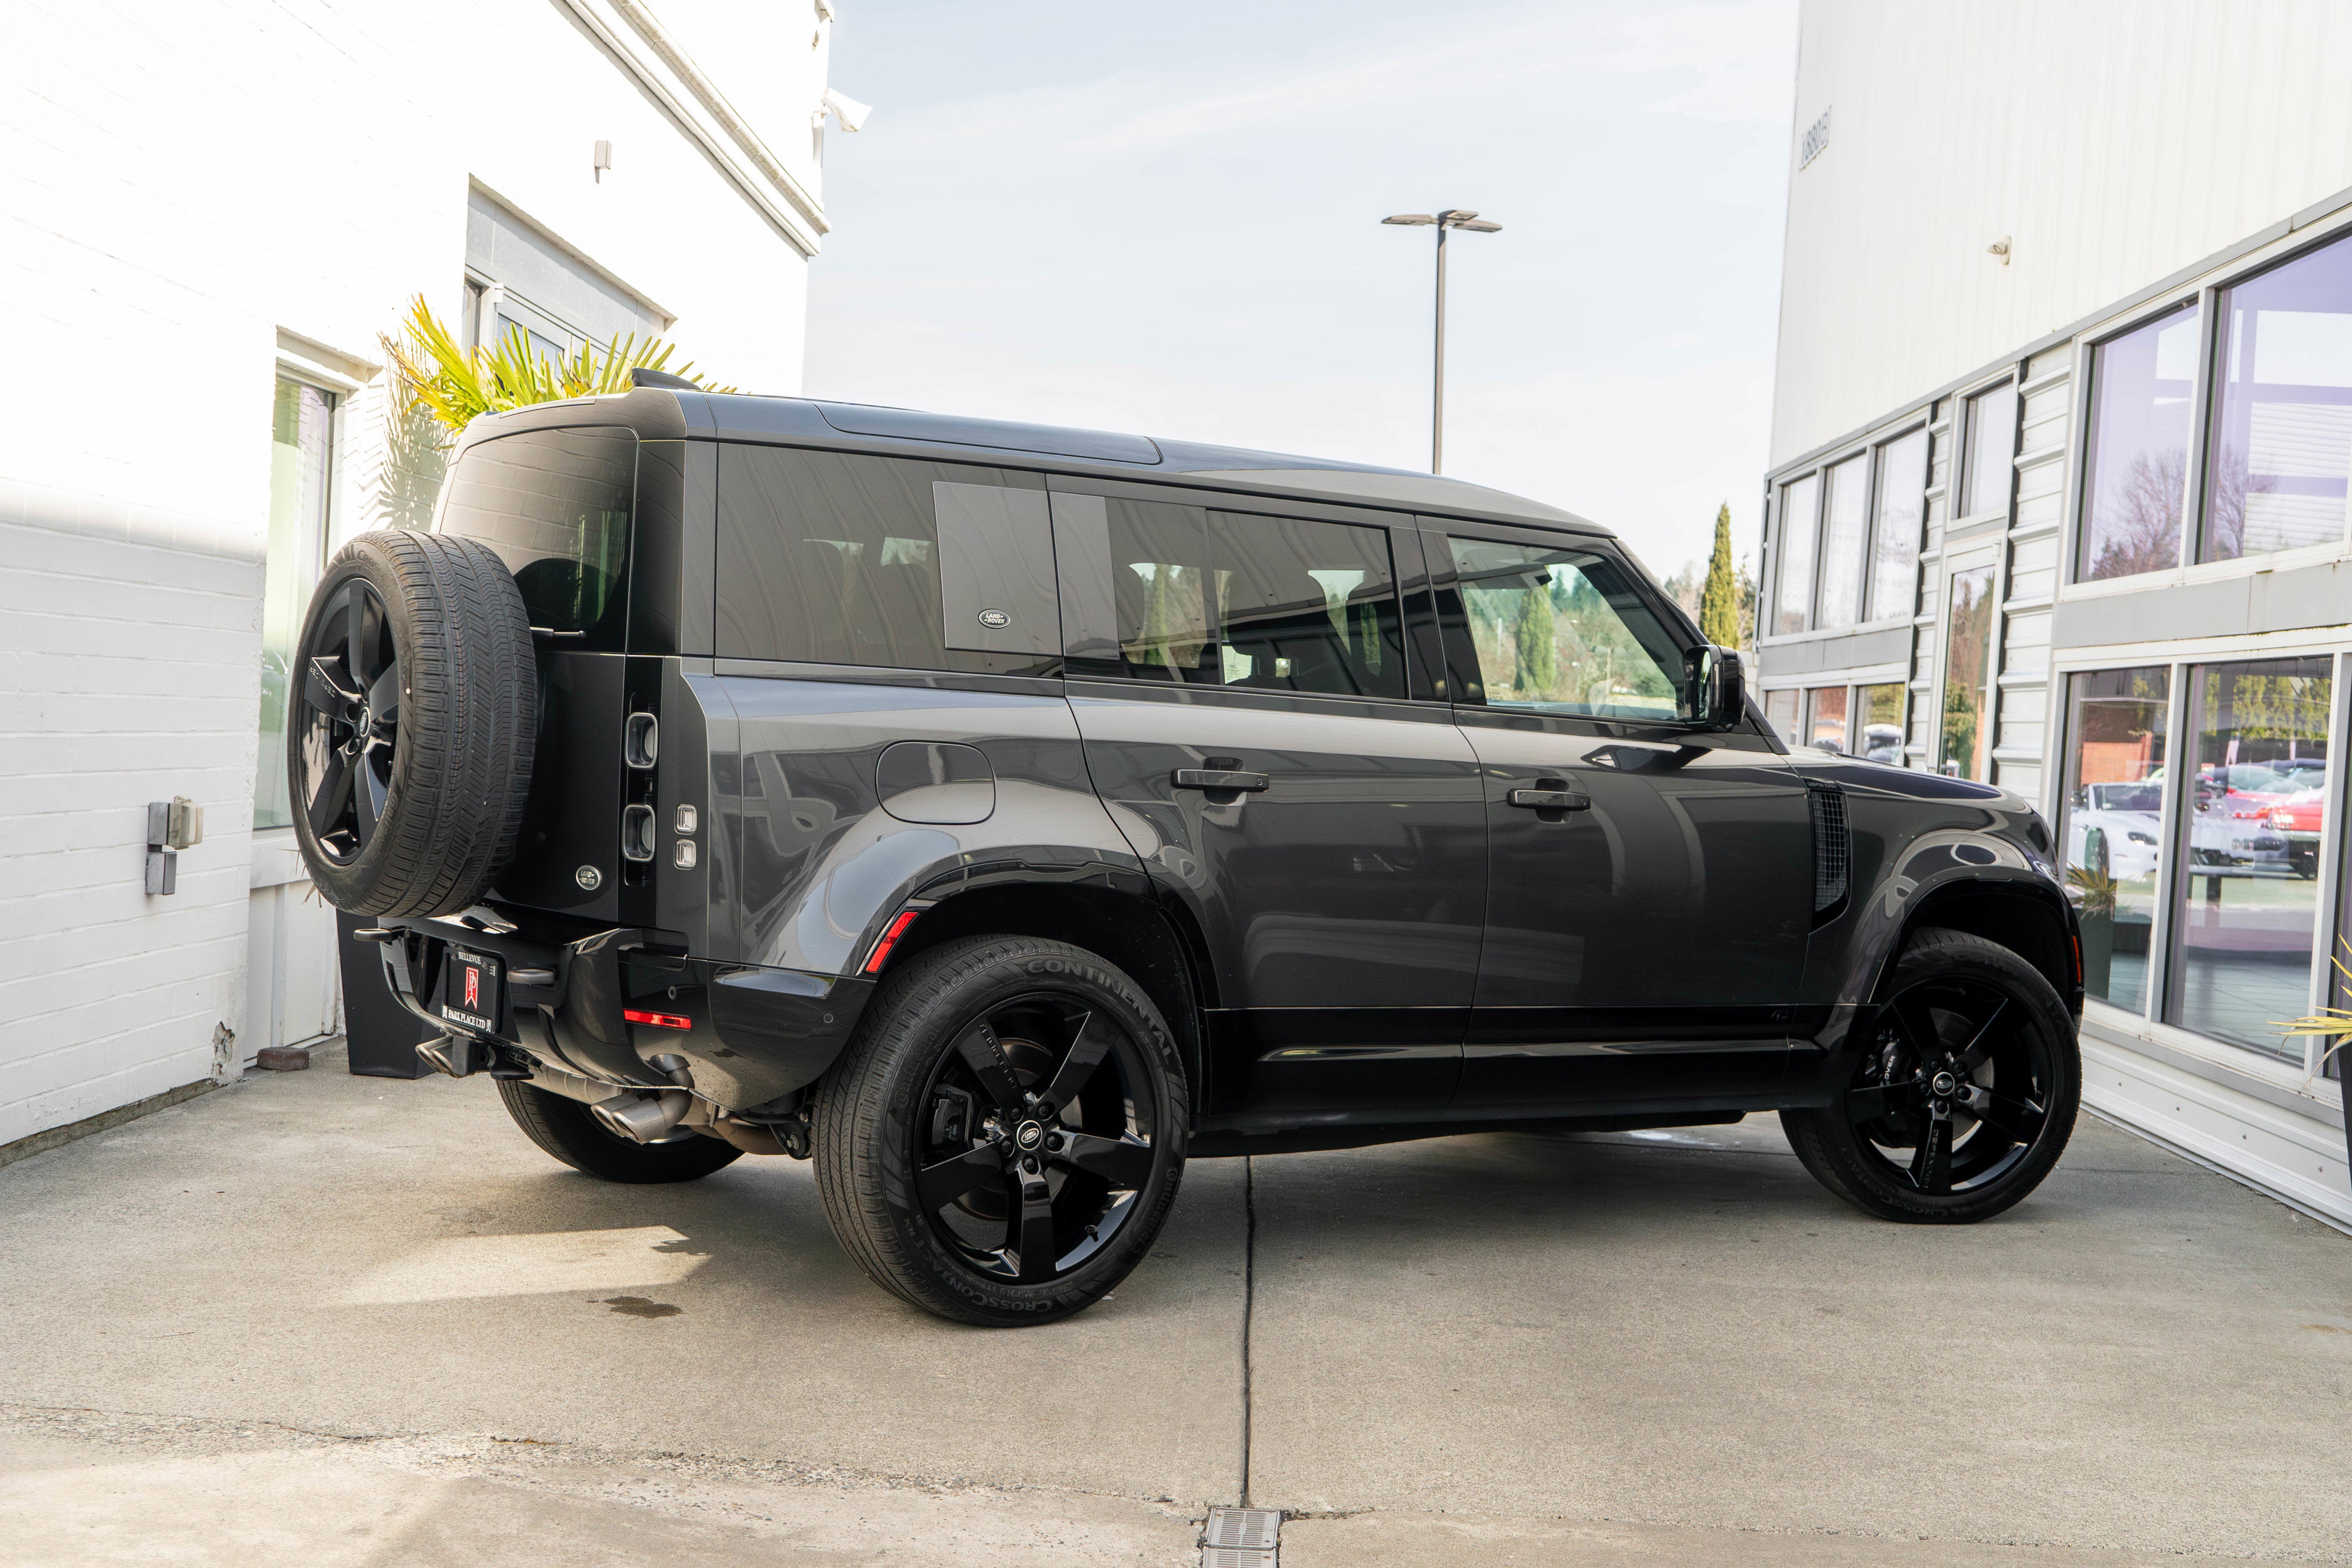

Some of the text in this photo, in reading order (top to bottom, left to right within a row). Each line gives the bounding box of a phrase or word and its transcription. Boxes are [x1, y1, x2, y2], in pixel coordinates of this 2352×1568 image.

[581, 877, 595, 885] ROVER
[458, 951, 481, 964] BELLEVUE
[448, 1009, 461, 1021] PARK
[460, 1012, 476, 1027] PLACE
[476, 1018, 486, 1029] LTD
[1027, 959, 1172, 1065] CONTINENTAL
